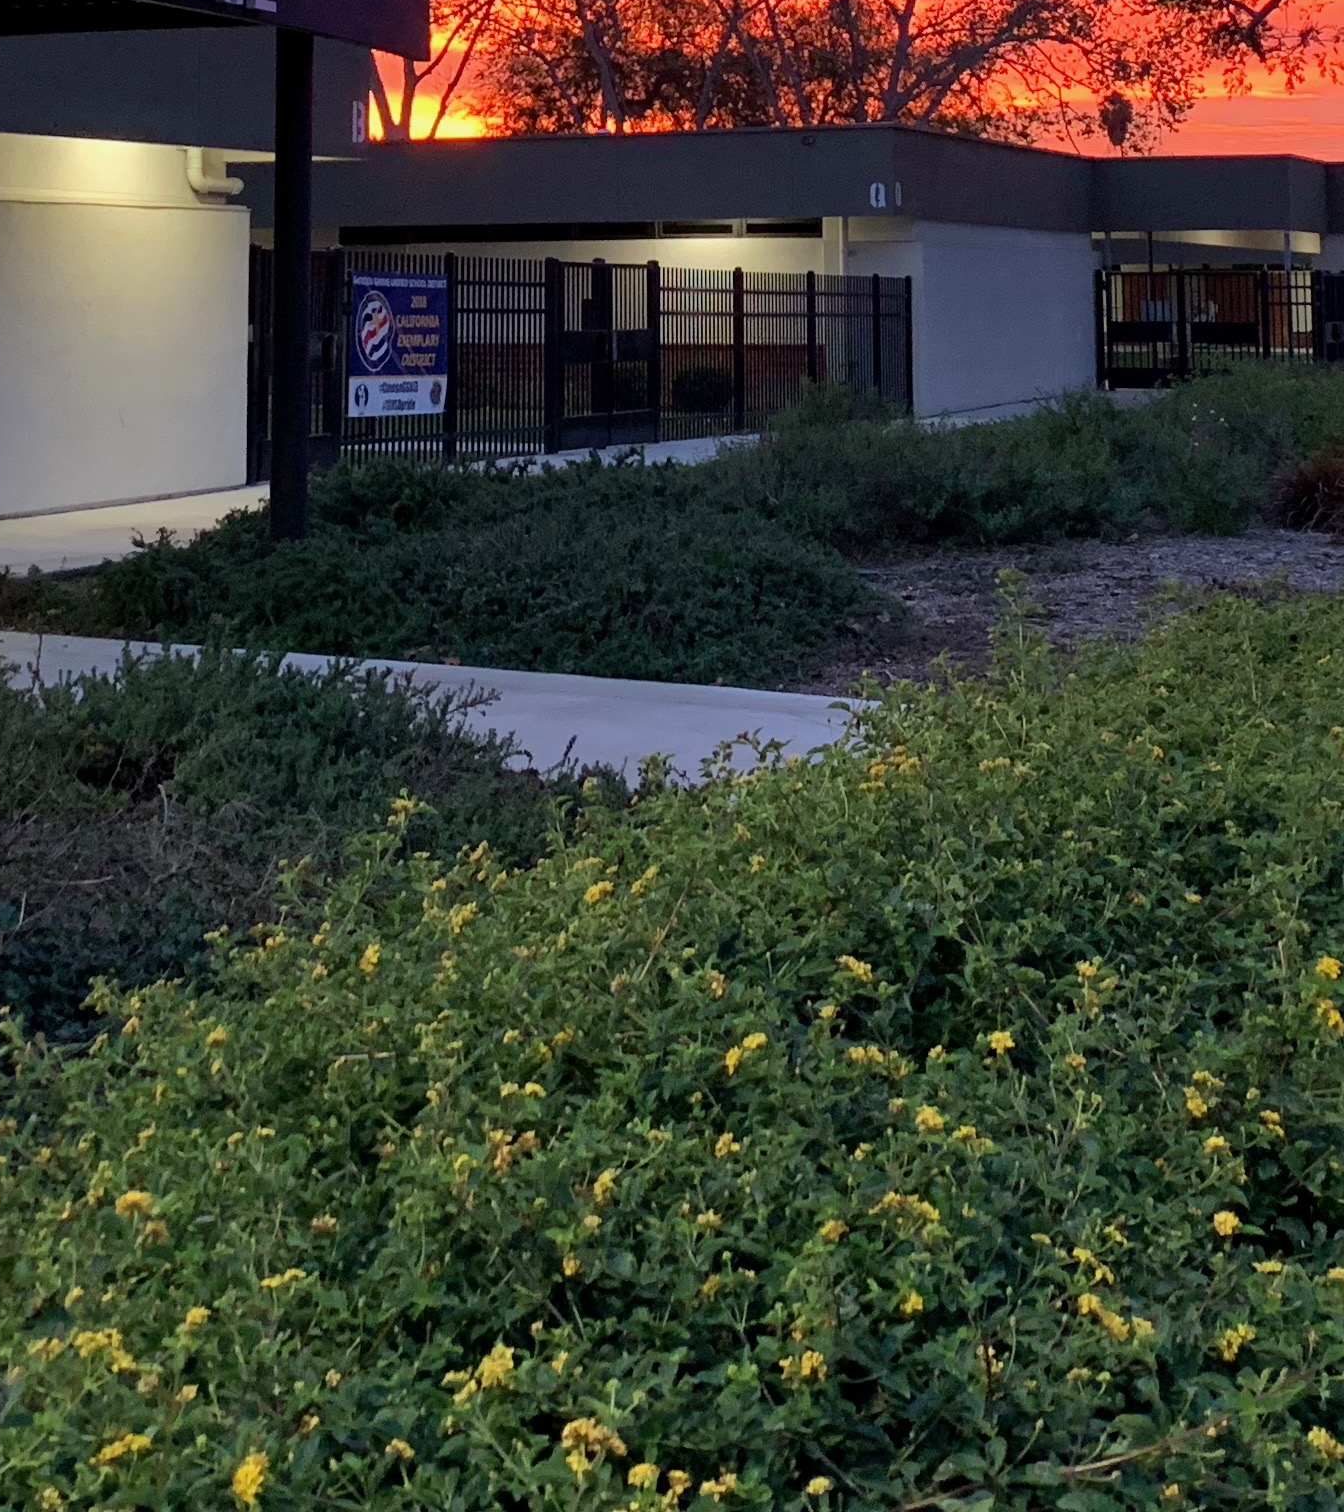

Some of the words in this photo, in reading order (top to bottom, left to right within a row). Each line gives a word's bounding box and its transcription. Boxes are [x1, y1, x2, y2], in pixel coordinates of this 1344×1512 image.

[352, 100, 366, 143] B
[396, 314, 440, 328] CALIFORNIA
[397, 334, 440, 348] EXEMPLARY
[401, 353, 437, 367] DISTRICT
